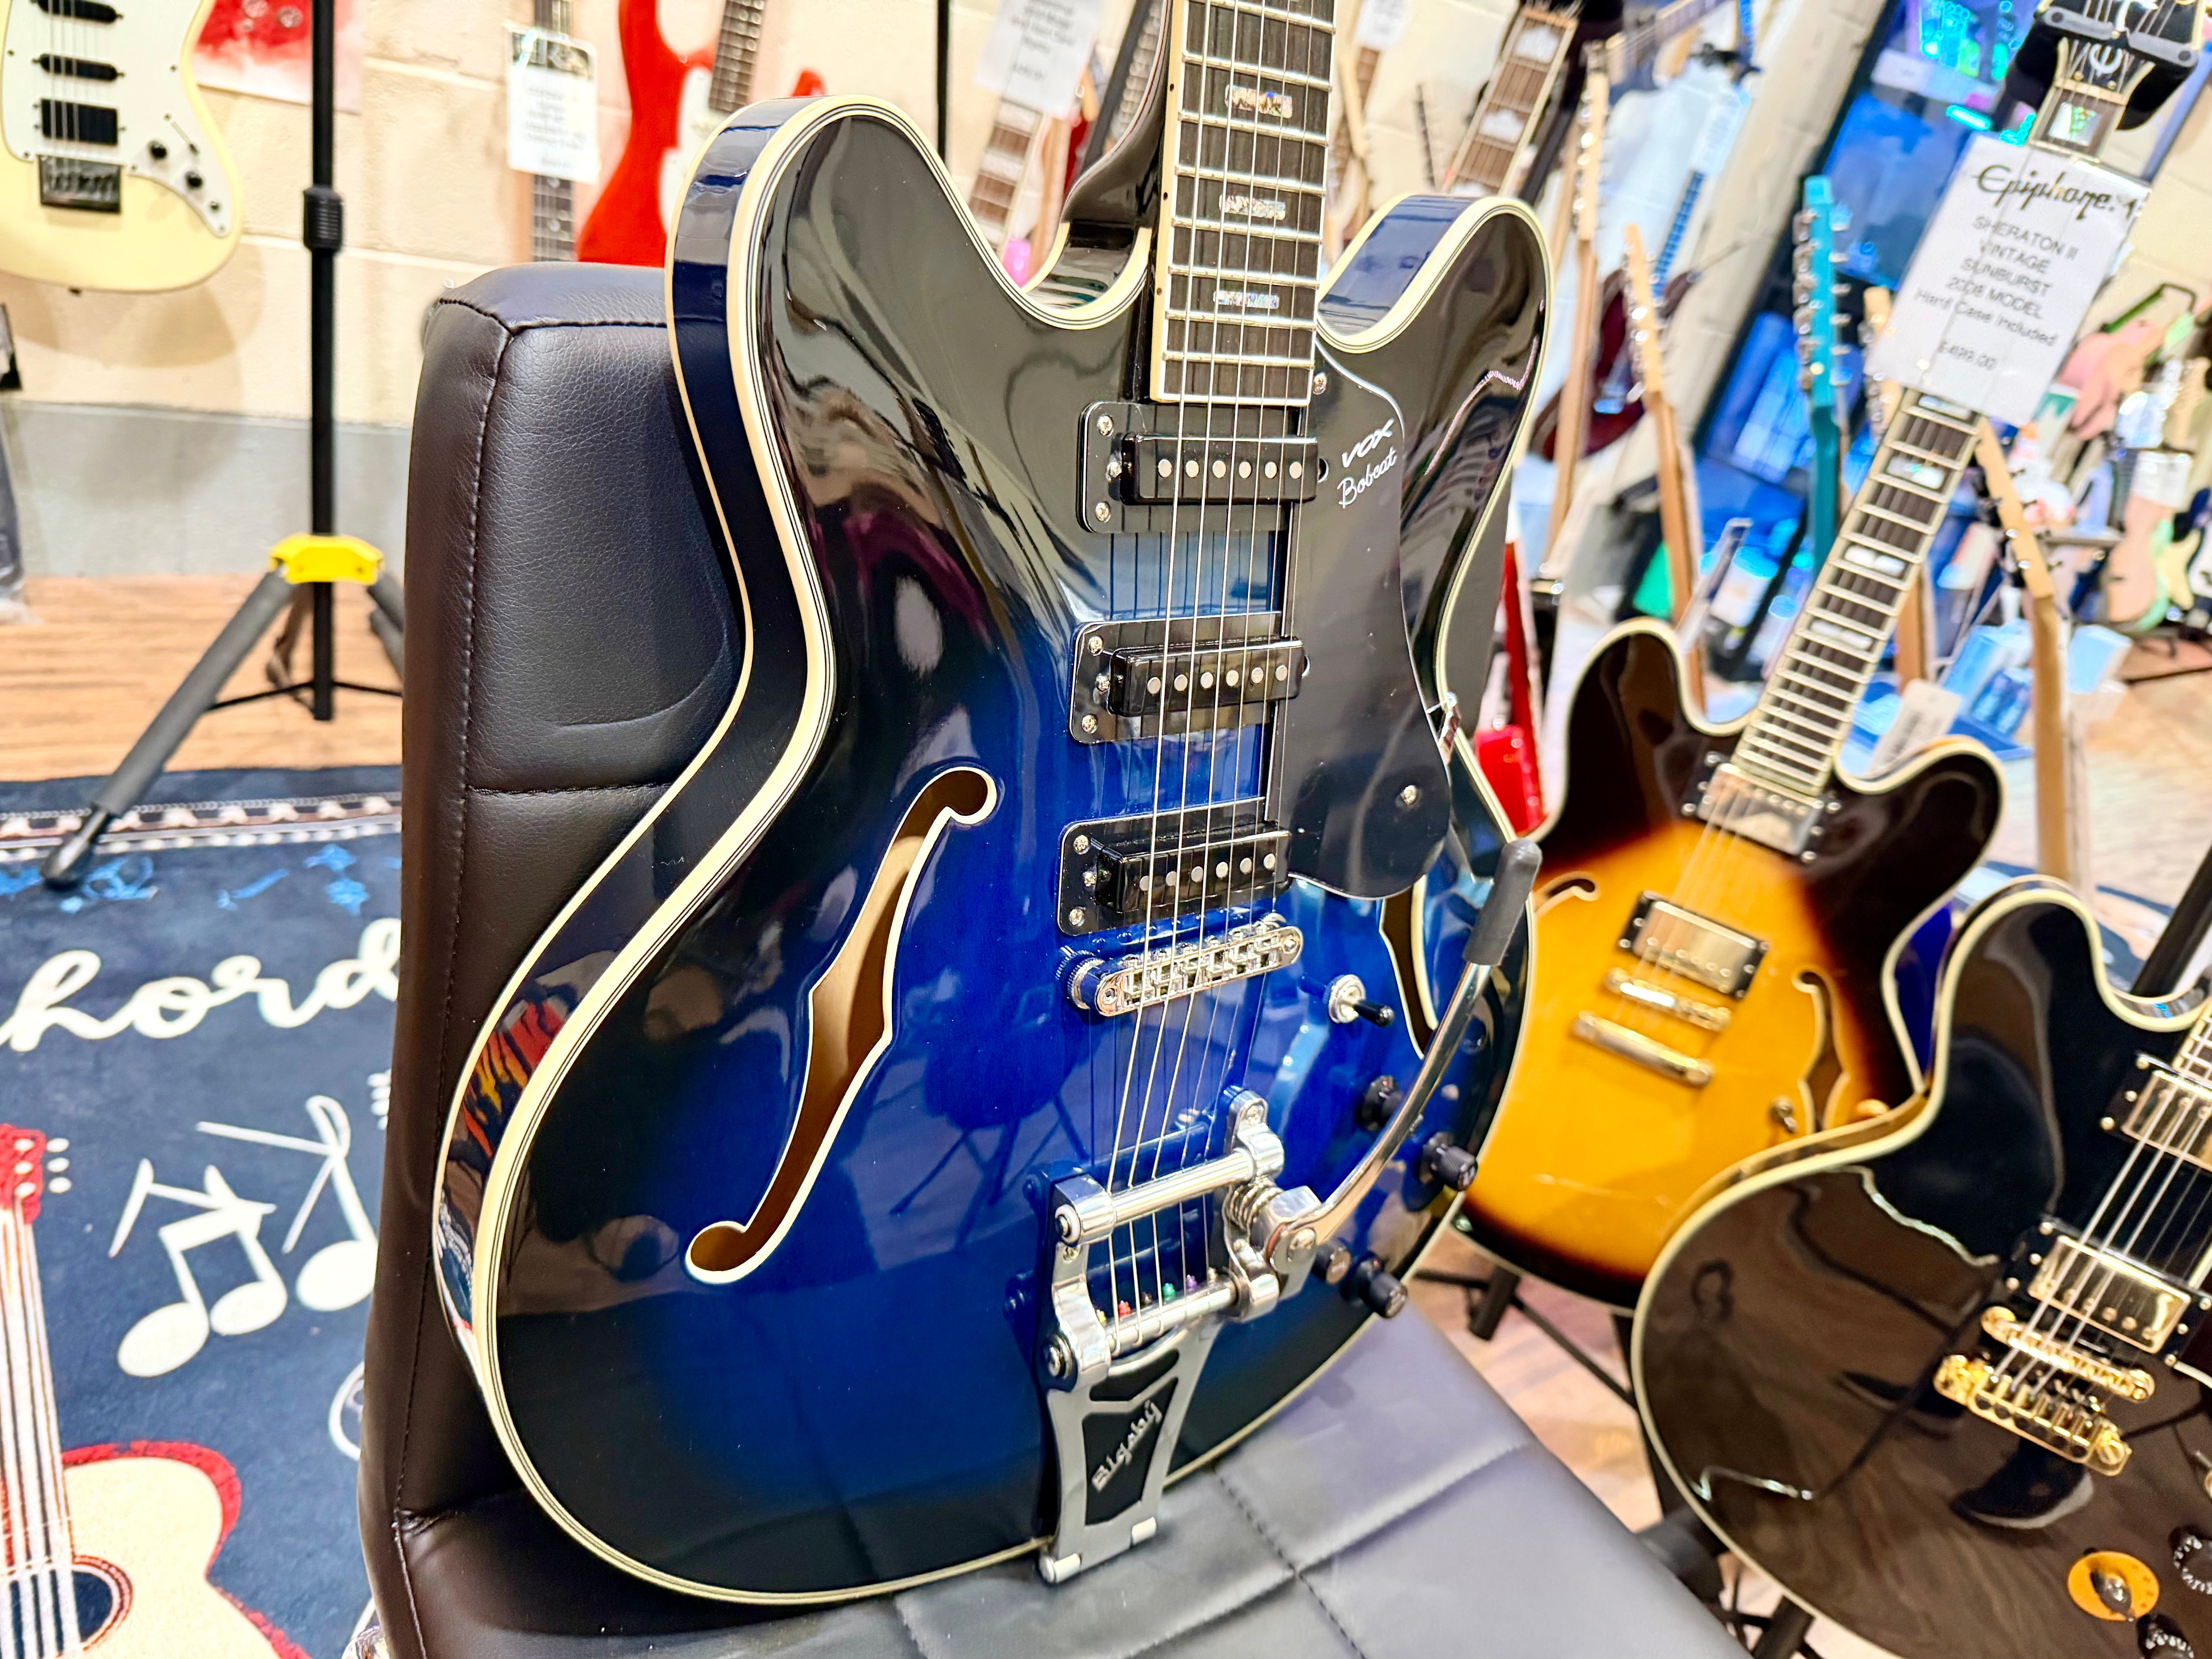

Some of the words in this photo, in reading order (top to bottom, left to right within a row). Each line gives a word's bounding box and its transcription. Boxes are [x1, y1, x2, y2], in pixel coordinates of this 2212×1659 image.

[1973, 216, 2064, 255] SHERATON
[1980, 238, 2051, 273] VINTAGE
[1961, 257, 2052, 297] SUNBURST
[1914, 287, 1953, 310] Hard
[1955, 301, 1993, 323] Case
[1995, 313, 2059, 347] Included
[1986, 287, 2043, 320] MODEL
[1341, 418, 1395, 468] VOX
[1337, 446, 1398, 508] Bobcat
[1091, 1399, 1163, 1492] Bigsby
